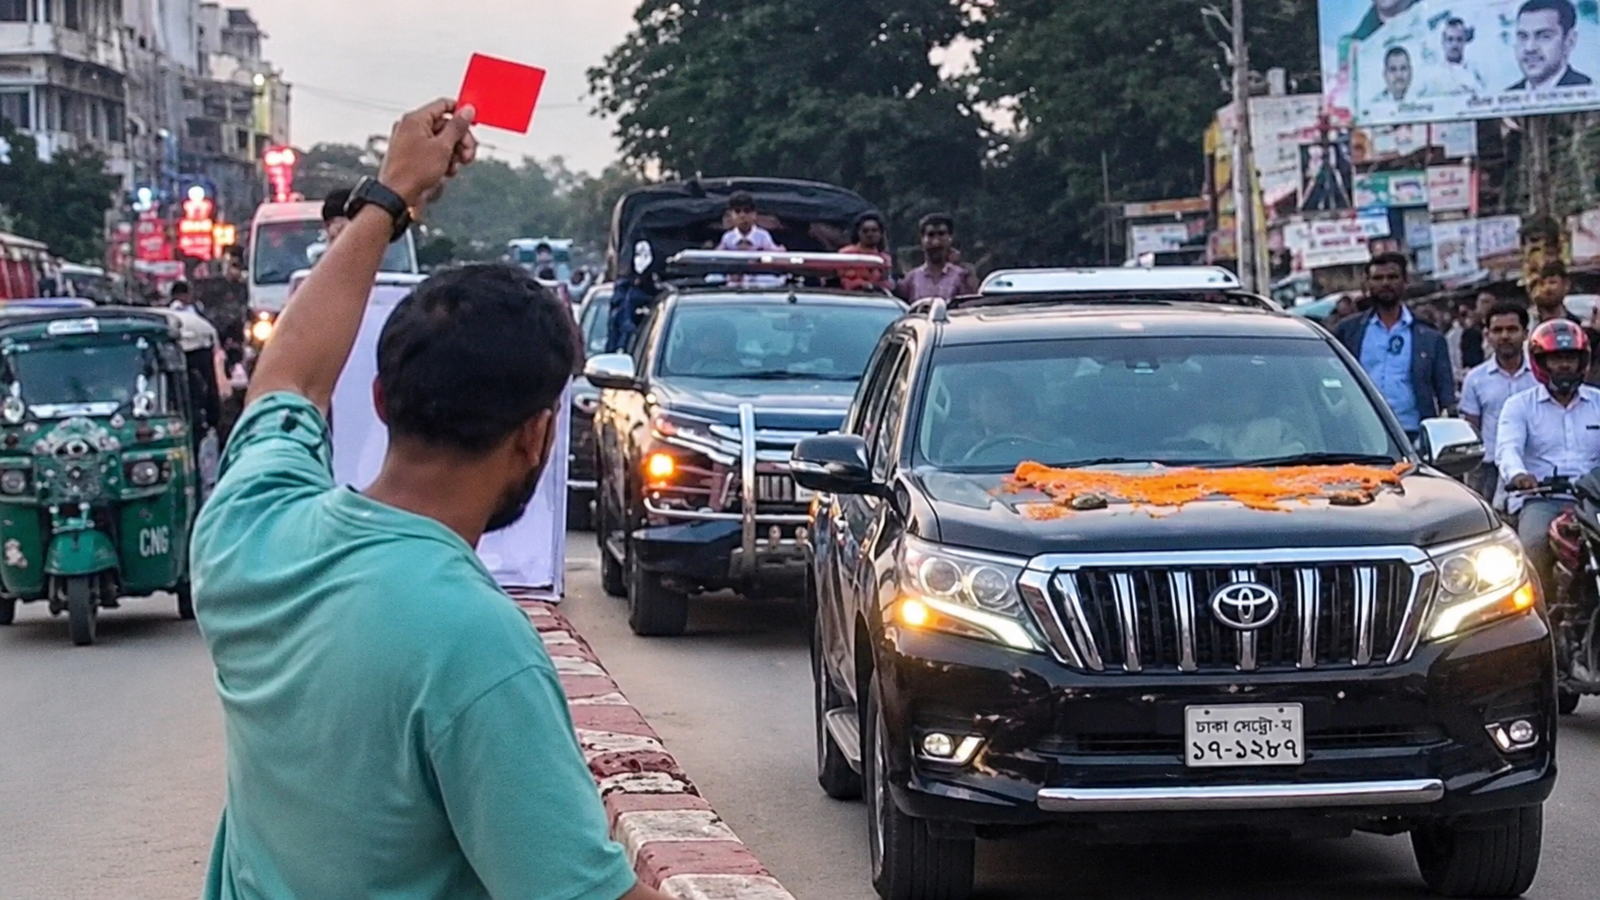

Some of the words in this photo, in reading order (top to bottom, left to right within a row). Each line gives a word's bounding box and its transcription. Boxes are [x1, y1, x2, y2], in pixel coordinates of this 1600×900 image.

[139, 525, 169, 558] CNG
[1195, 719, 1229, 734] ঢাকা
[1193, 739, 1298, 760] ১৭-১২৪৭
